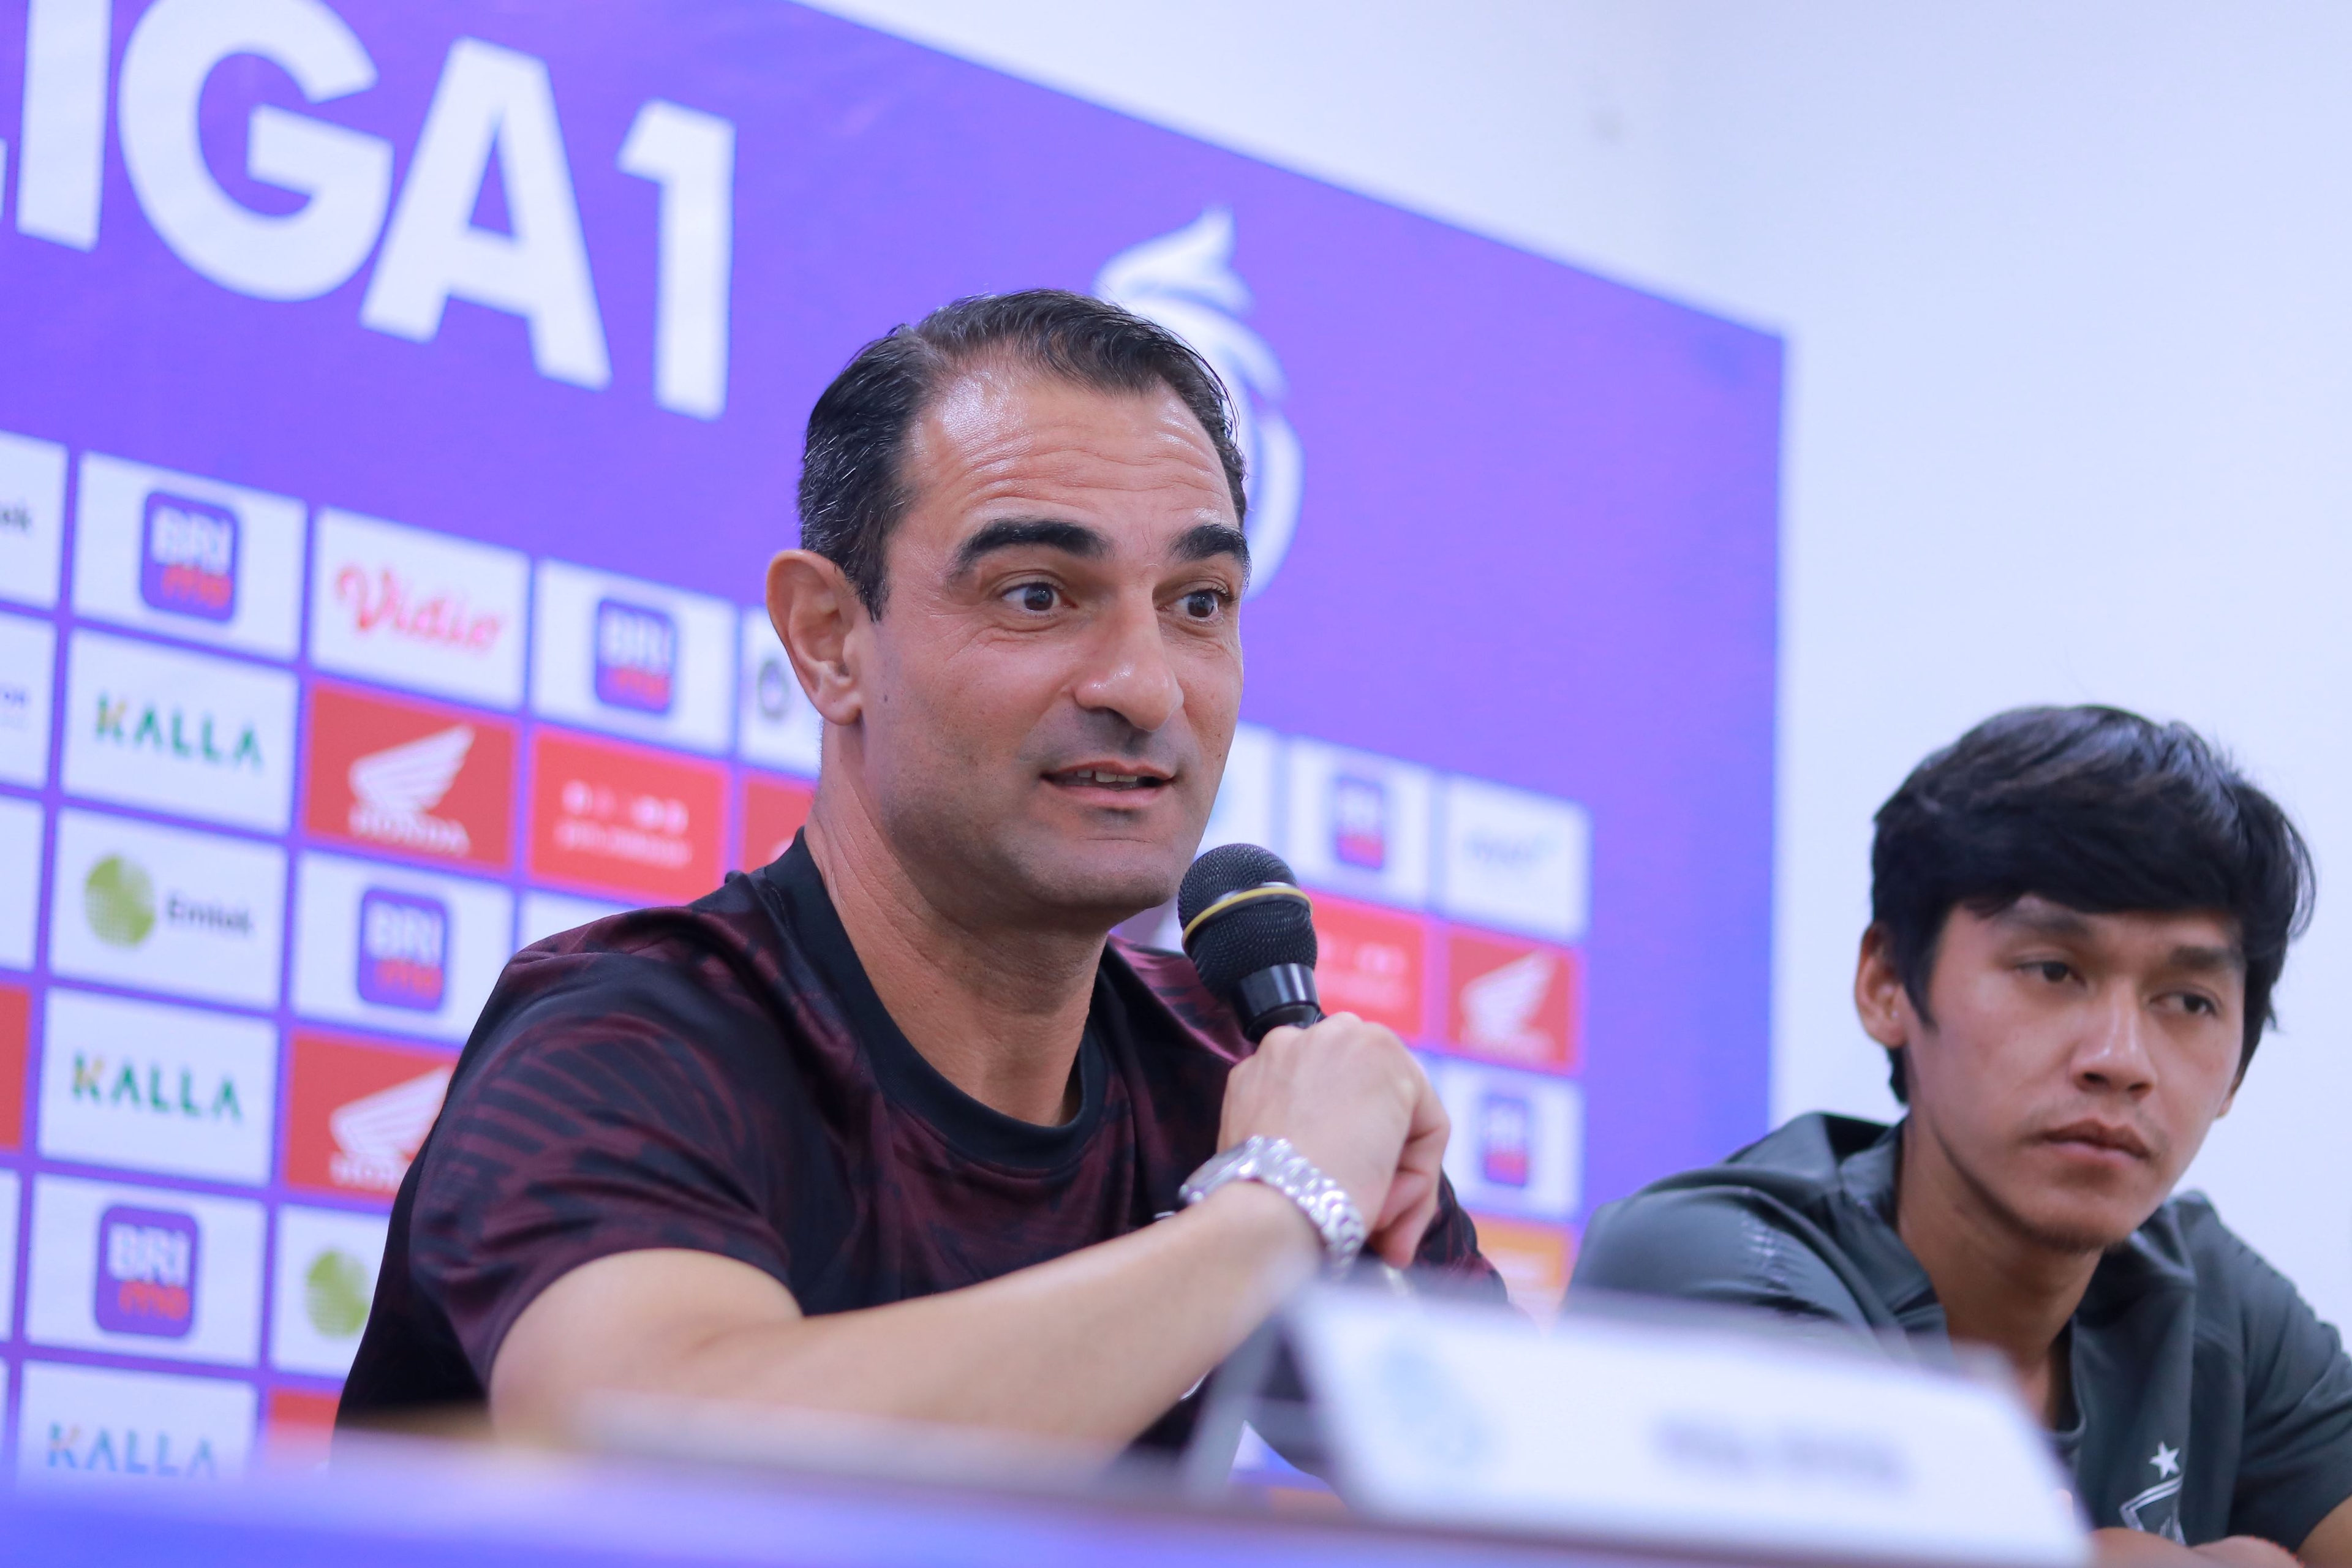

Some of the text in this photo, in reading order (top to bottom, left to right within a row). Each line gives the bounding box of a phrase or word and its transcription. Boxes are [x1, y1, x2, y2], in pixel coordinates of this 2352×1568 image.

[0, 0, 737, 423] IGA1
[151, 505, 233, 573] BRI
[336, 563, 502, 652] Vidio
[95, 693, 263, 769] KALLA
[366, 902, 443, 967] BRI
[72, 1048, 243, 1121] KALLA
[107, 1223, 190, 1287] BRI
[47, 1421, 217, 1478] KALLA
